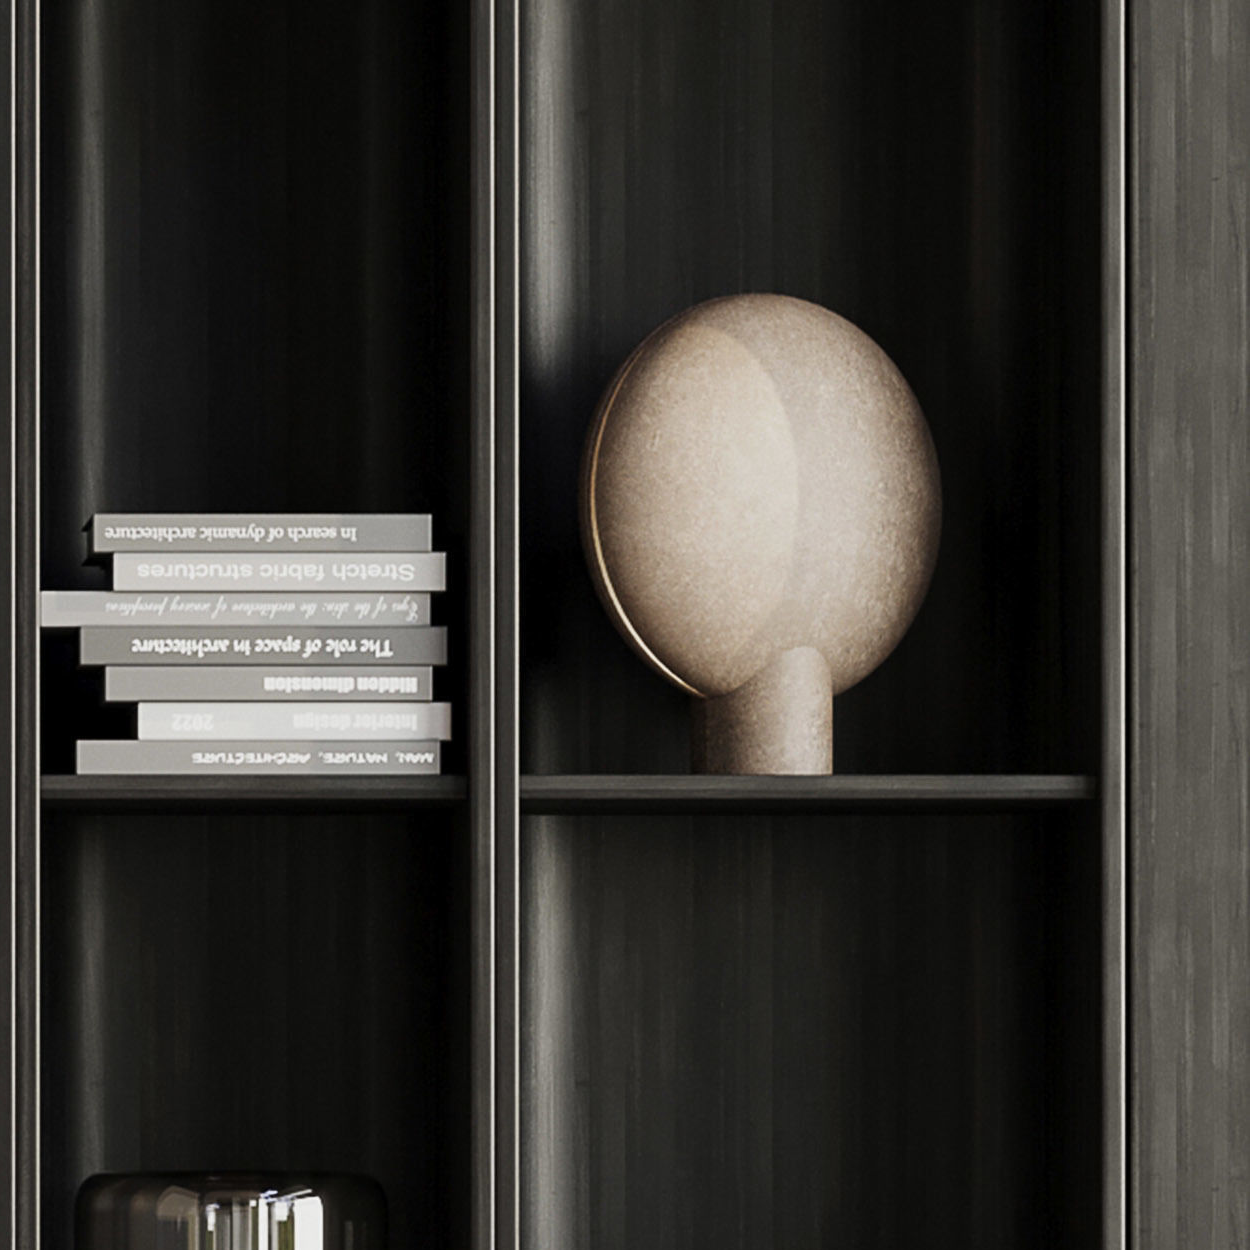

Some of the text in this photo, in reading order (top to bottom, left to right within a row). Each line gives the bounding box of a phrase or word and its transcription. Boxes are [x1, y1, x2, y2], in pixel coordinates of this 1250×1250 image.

[105, 522, 357, 542] In search of dynamic architecture
[137, 564, 415, 581] Stretch fabric structures
[131, 636, 393, 658] The role of space in architecture
[172, 714, 214, 730] 2022
